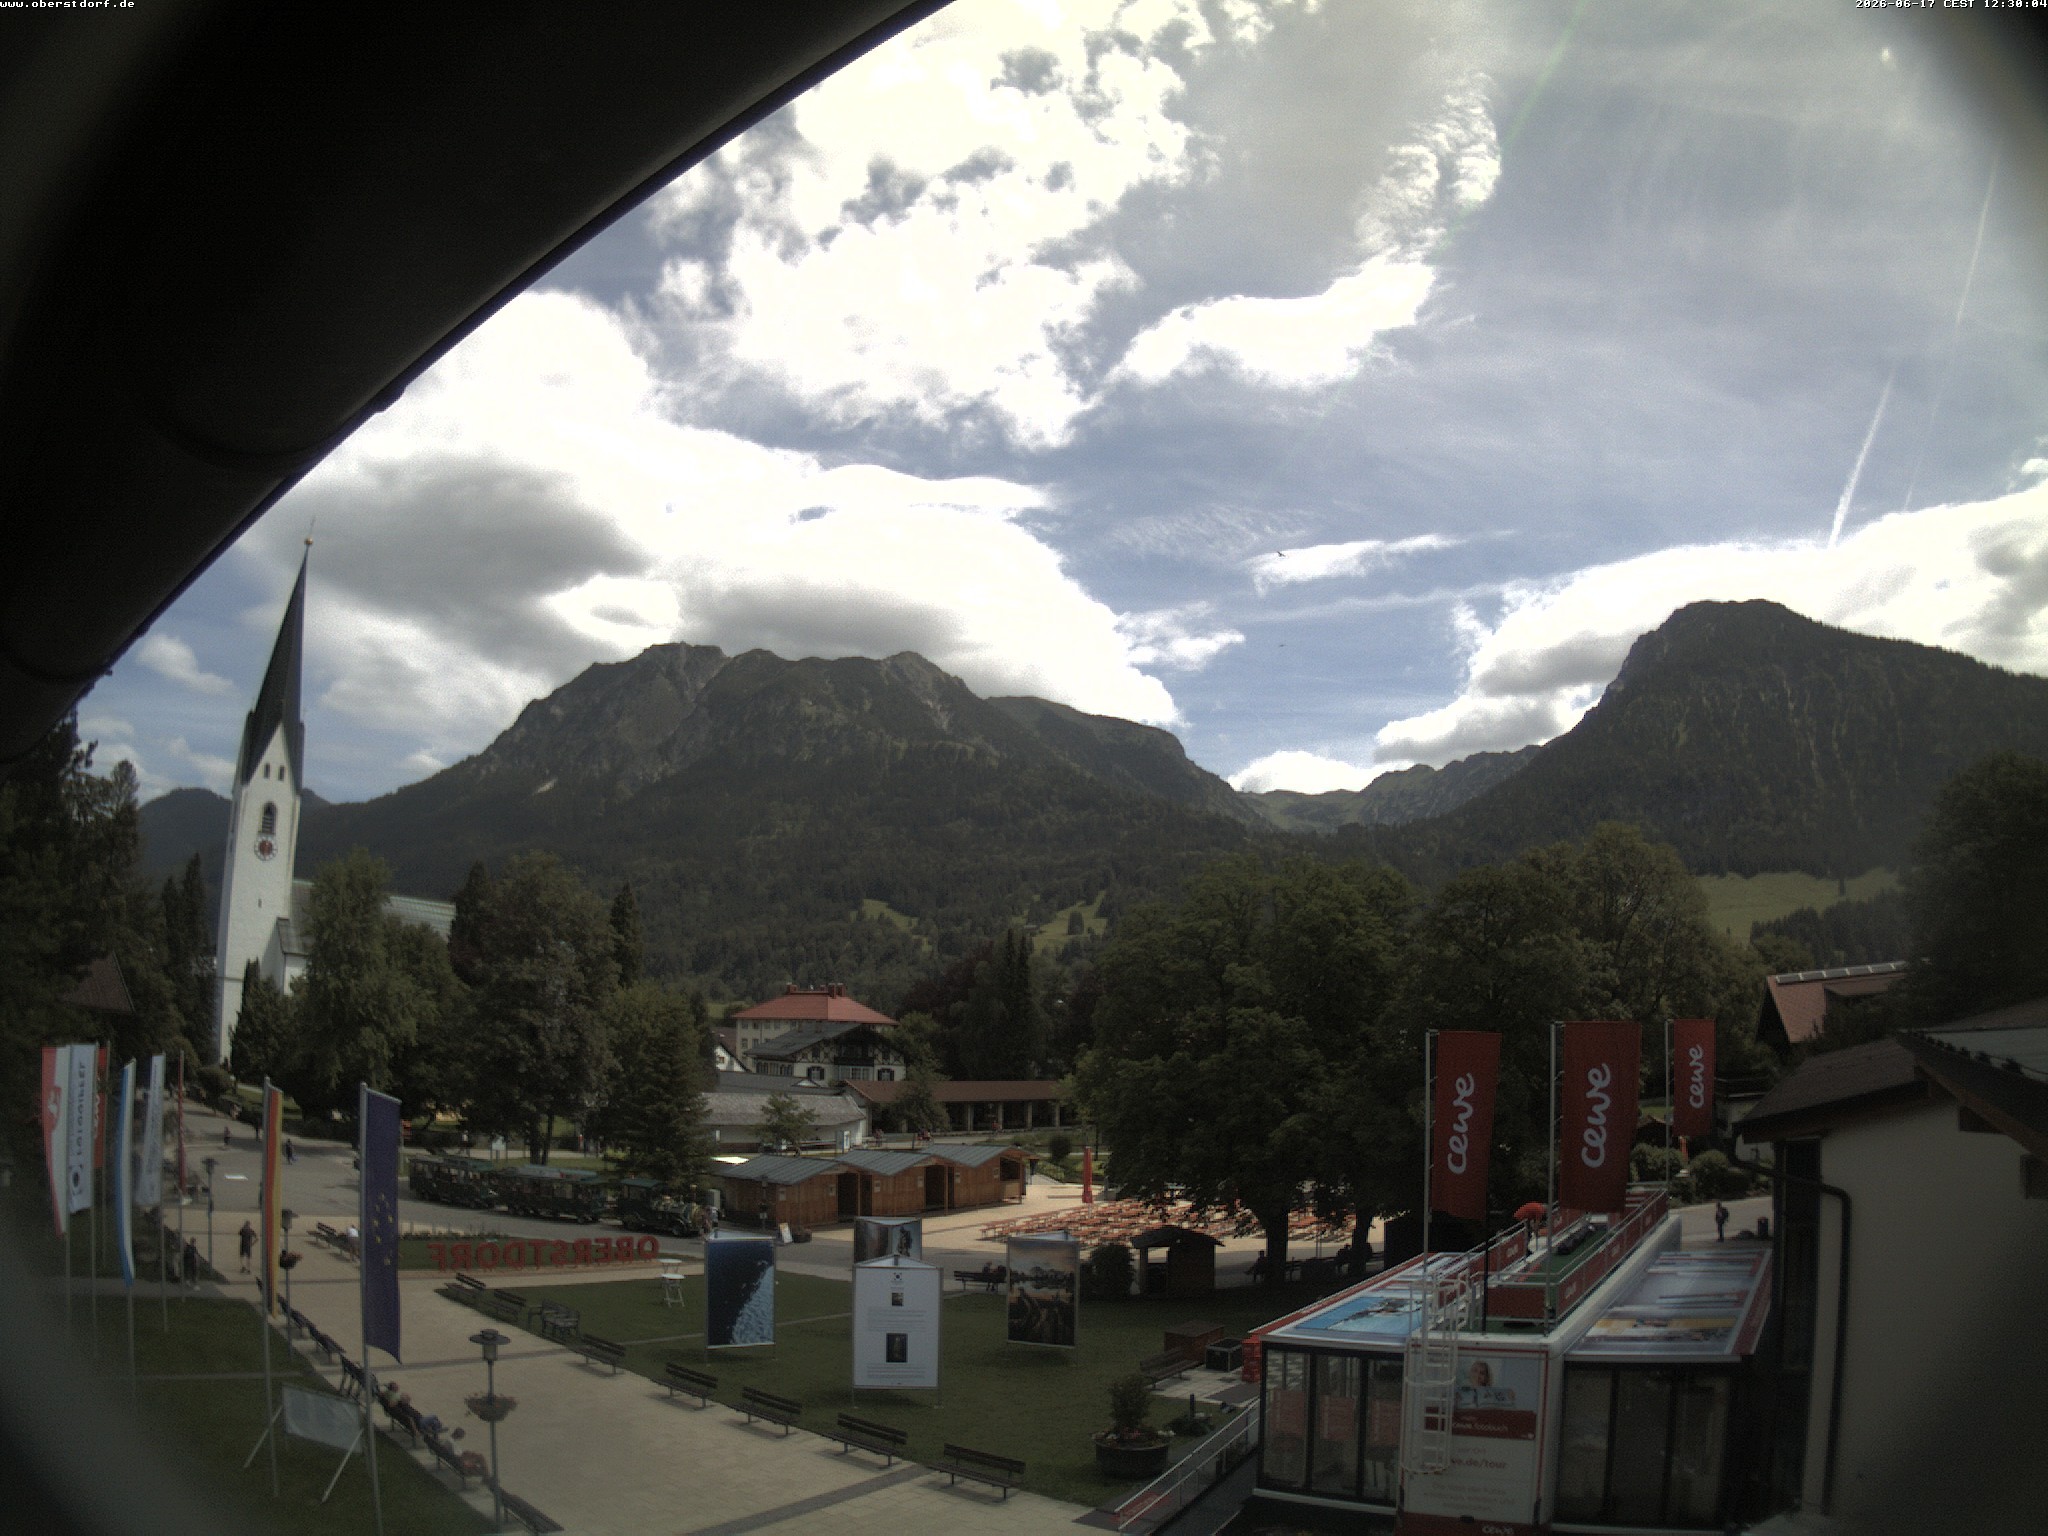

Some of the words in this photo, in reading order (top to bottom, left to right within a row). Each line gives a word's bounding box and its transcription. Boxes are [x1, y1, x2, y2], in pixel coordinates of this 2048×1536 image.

[1447, 1072, 1475, 1175] cewe
[1580, 1062, 1611, 1169] cewe
[1689, 1044, 1705, 1109] cewe
